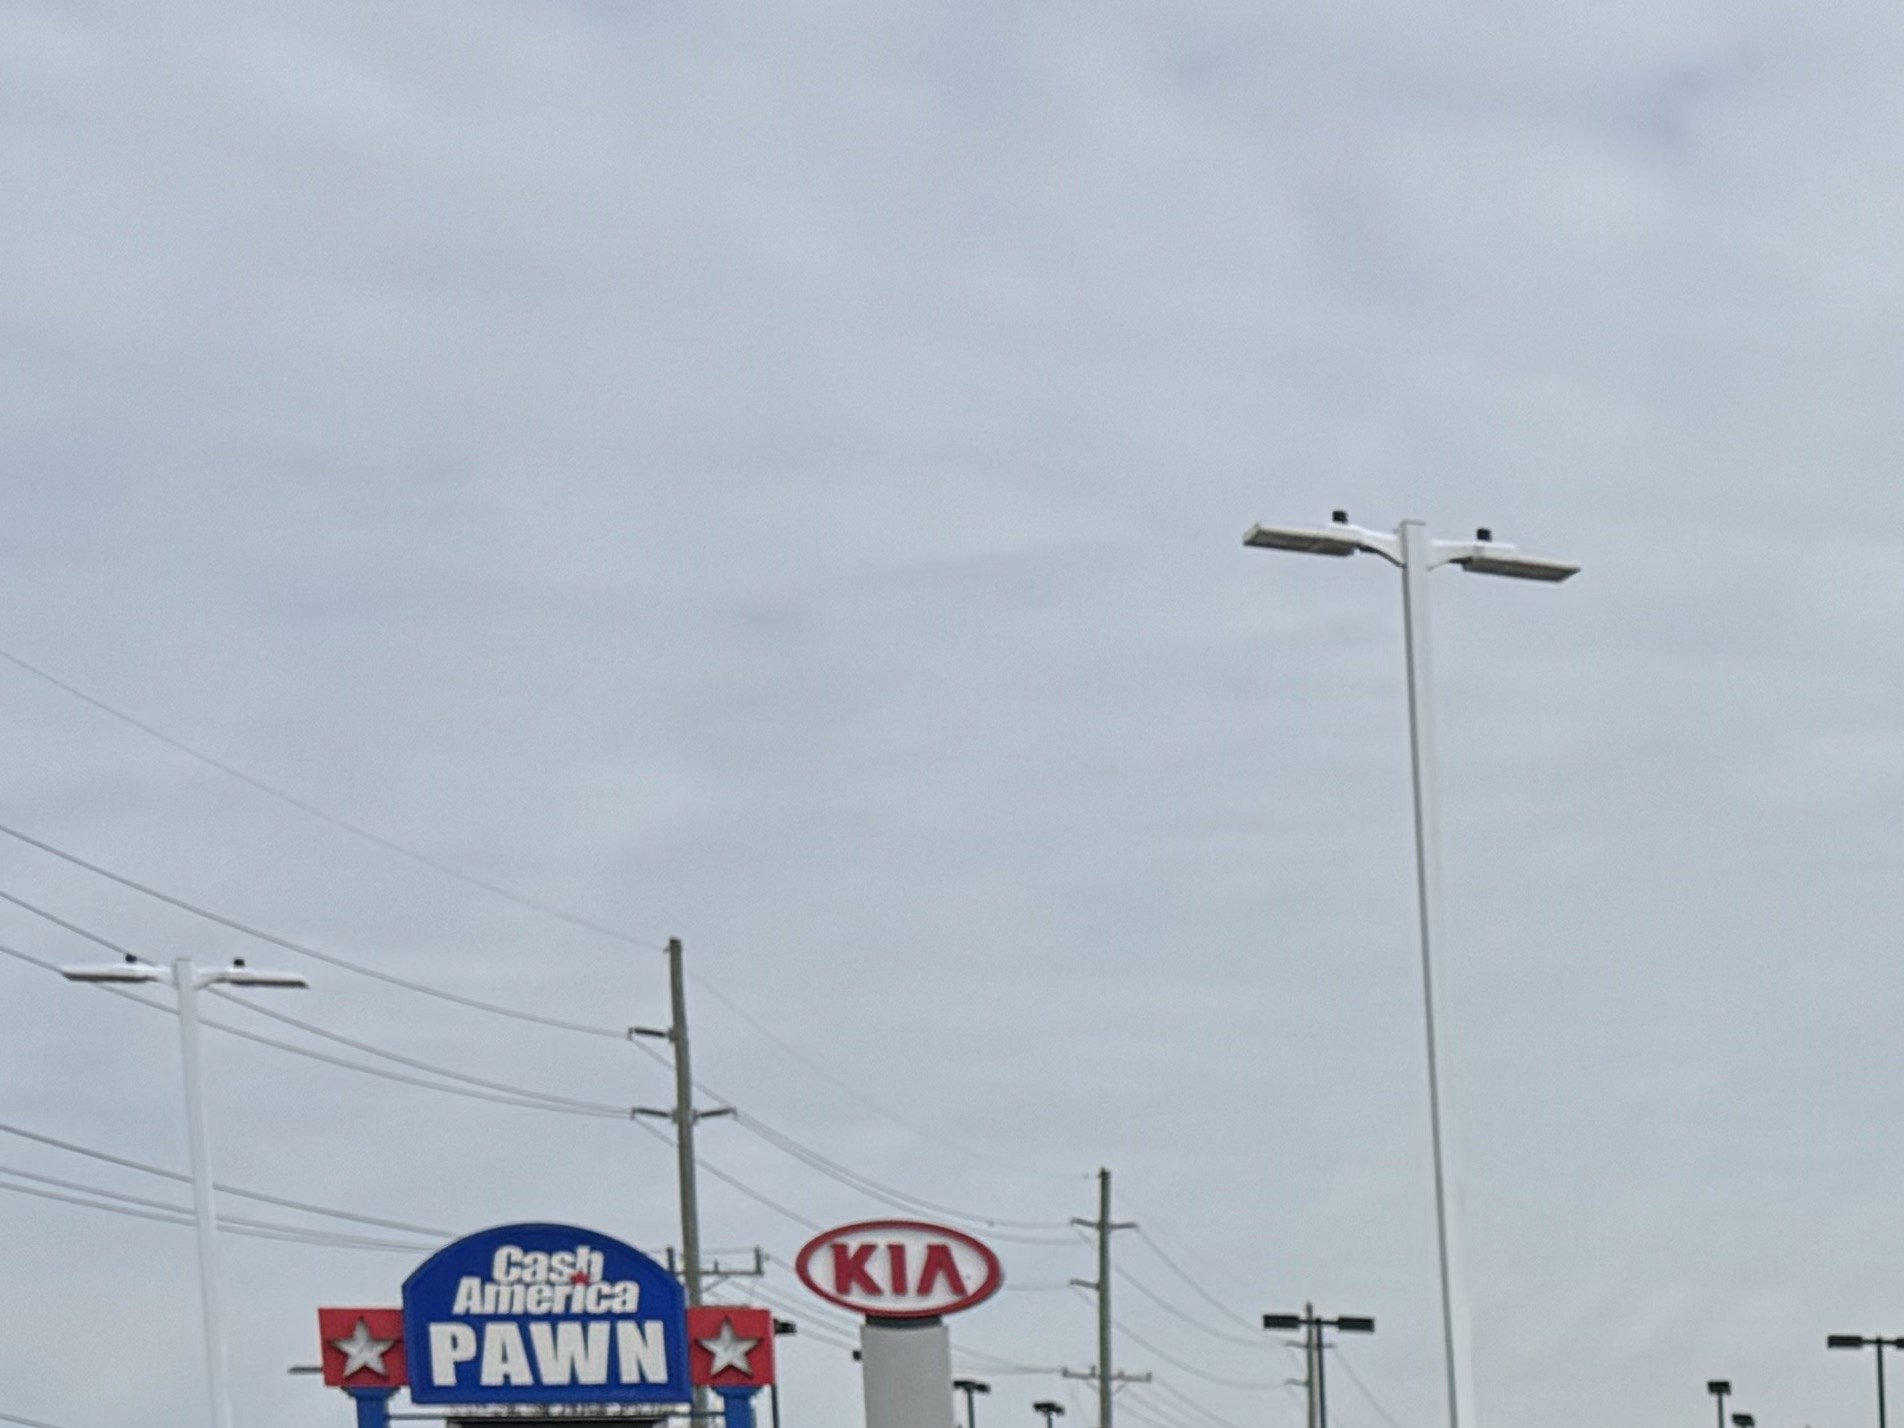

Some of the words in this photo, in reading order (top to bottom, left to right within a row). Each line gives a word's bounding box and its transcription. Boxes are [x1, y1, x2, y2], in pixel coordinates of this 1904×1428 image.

[492, 1244, 604, 1284] Cash
[830, 1243, 968, 1297] KIA
[451, 1277, 639, 1315] America
[429, 1320, 669, 1386] PAWN
